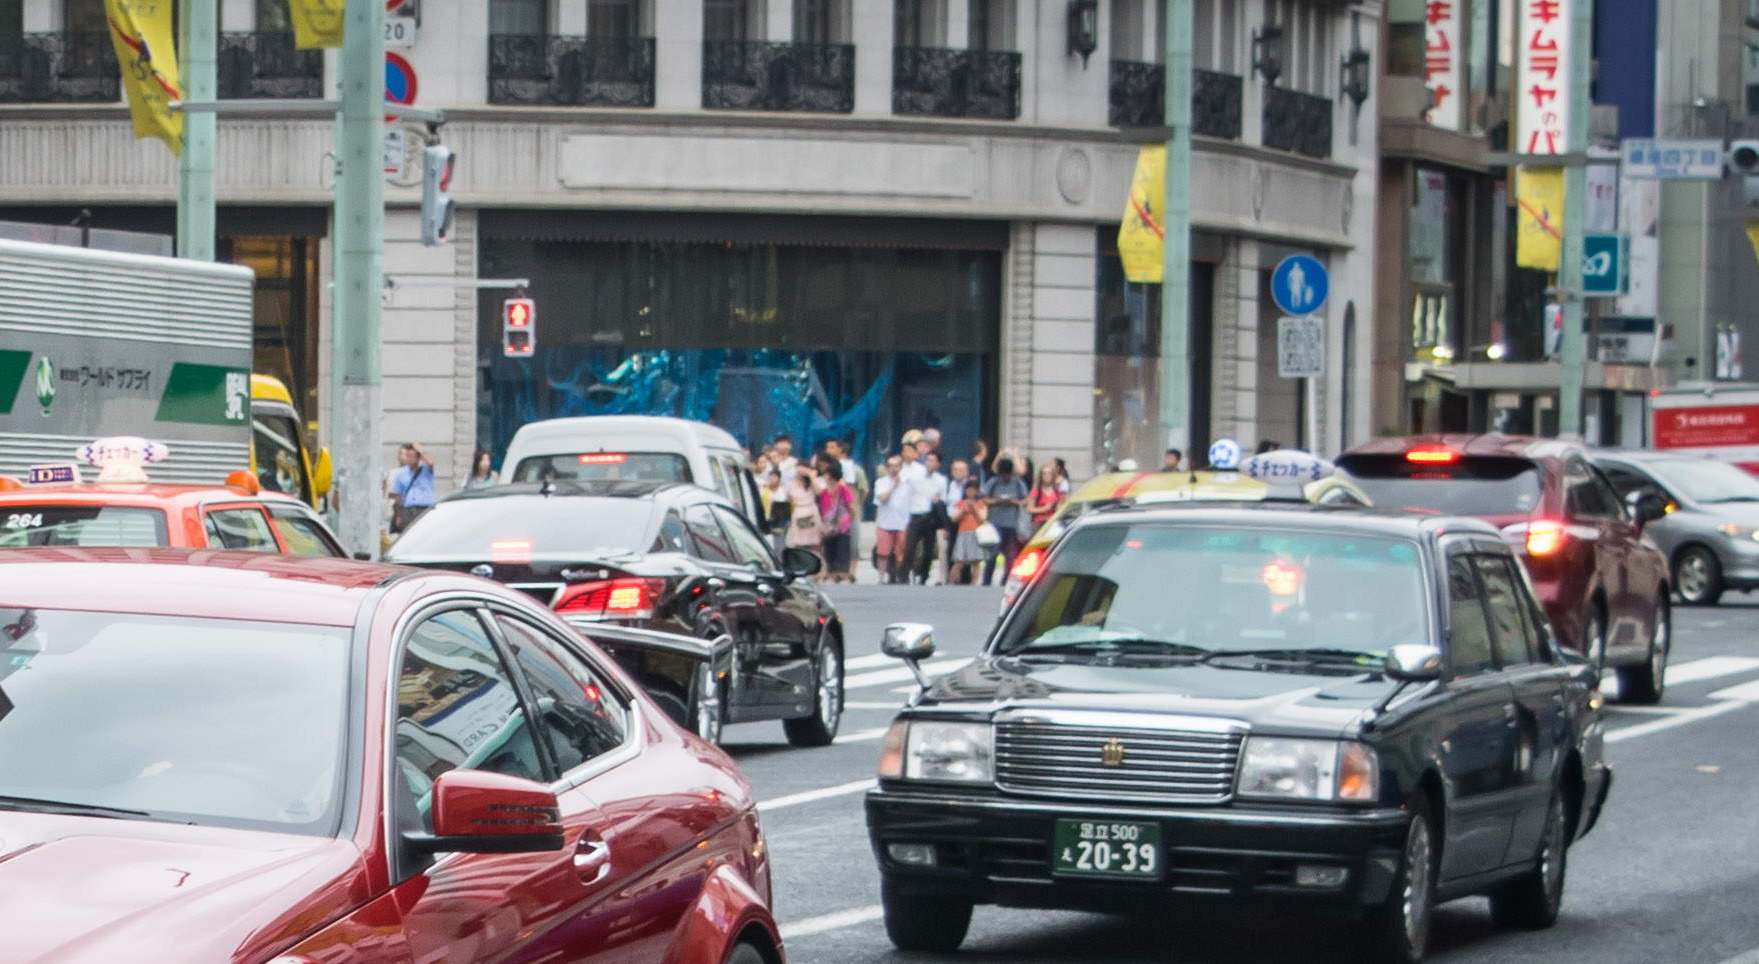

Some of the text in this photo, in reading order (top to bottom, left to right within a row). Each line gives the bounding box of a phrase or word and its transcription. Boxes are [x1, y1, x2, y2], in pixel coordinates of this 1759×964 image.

[1261, 459, 1307, 478] チェッカー
[6, 513, 43, 529] 264
[1076, 841, 1156, 873] 20-39
